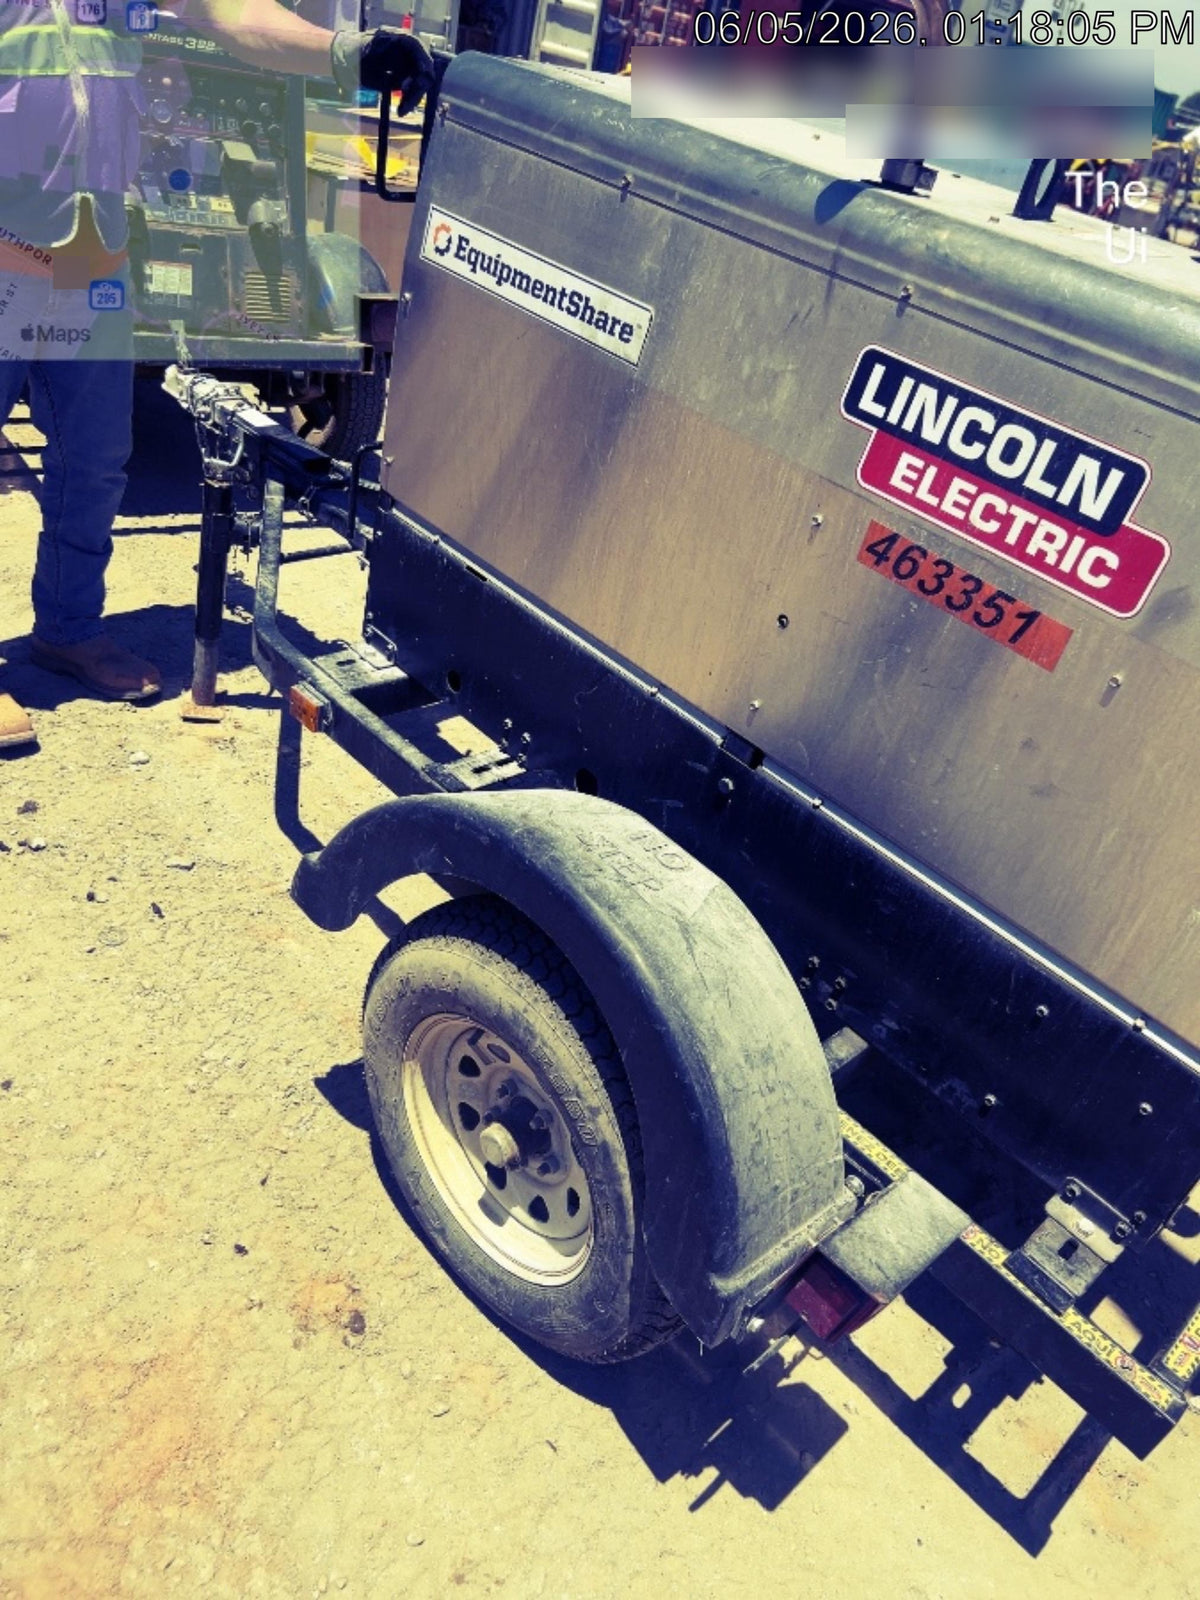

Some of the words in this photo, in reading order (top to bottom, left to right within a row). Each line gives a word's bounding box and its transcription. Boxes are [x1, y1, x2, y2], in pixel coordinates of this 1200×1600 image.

[453, 234, 635, 344] EquipmentShare
[858, 363, 1126, 523] LINCOLN
[888, 451, 1120, 590] ELECTRIC
[864, 531, 1042, 645] 463351
